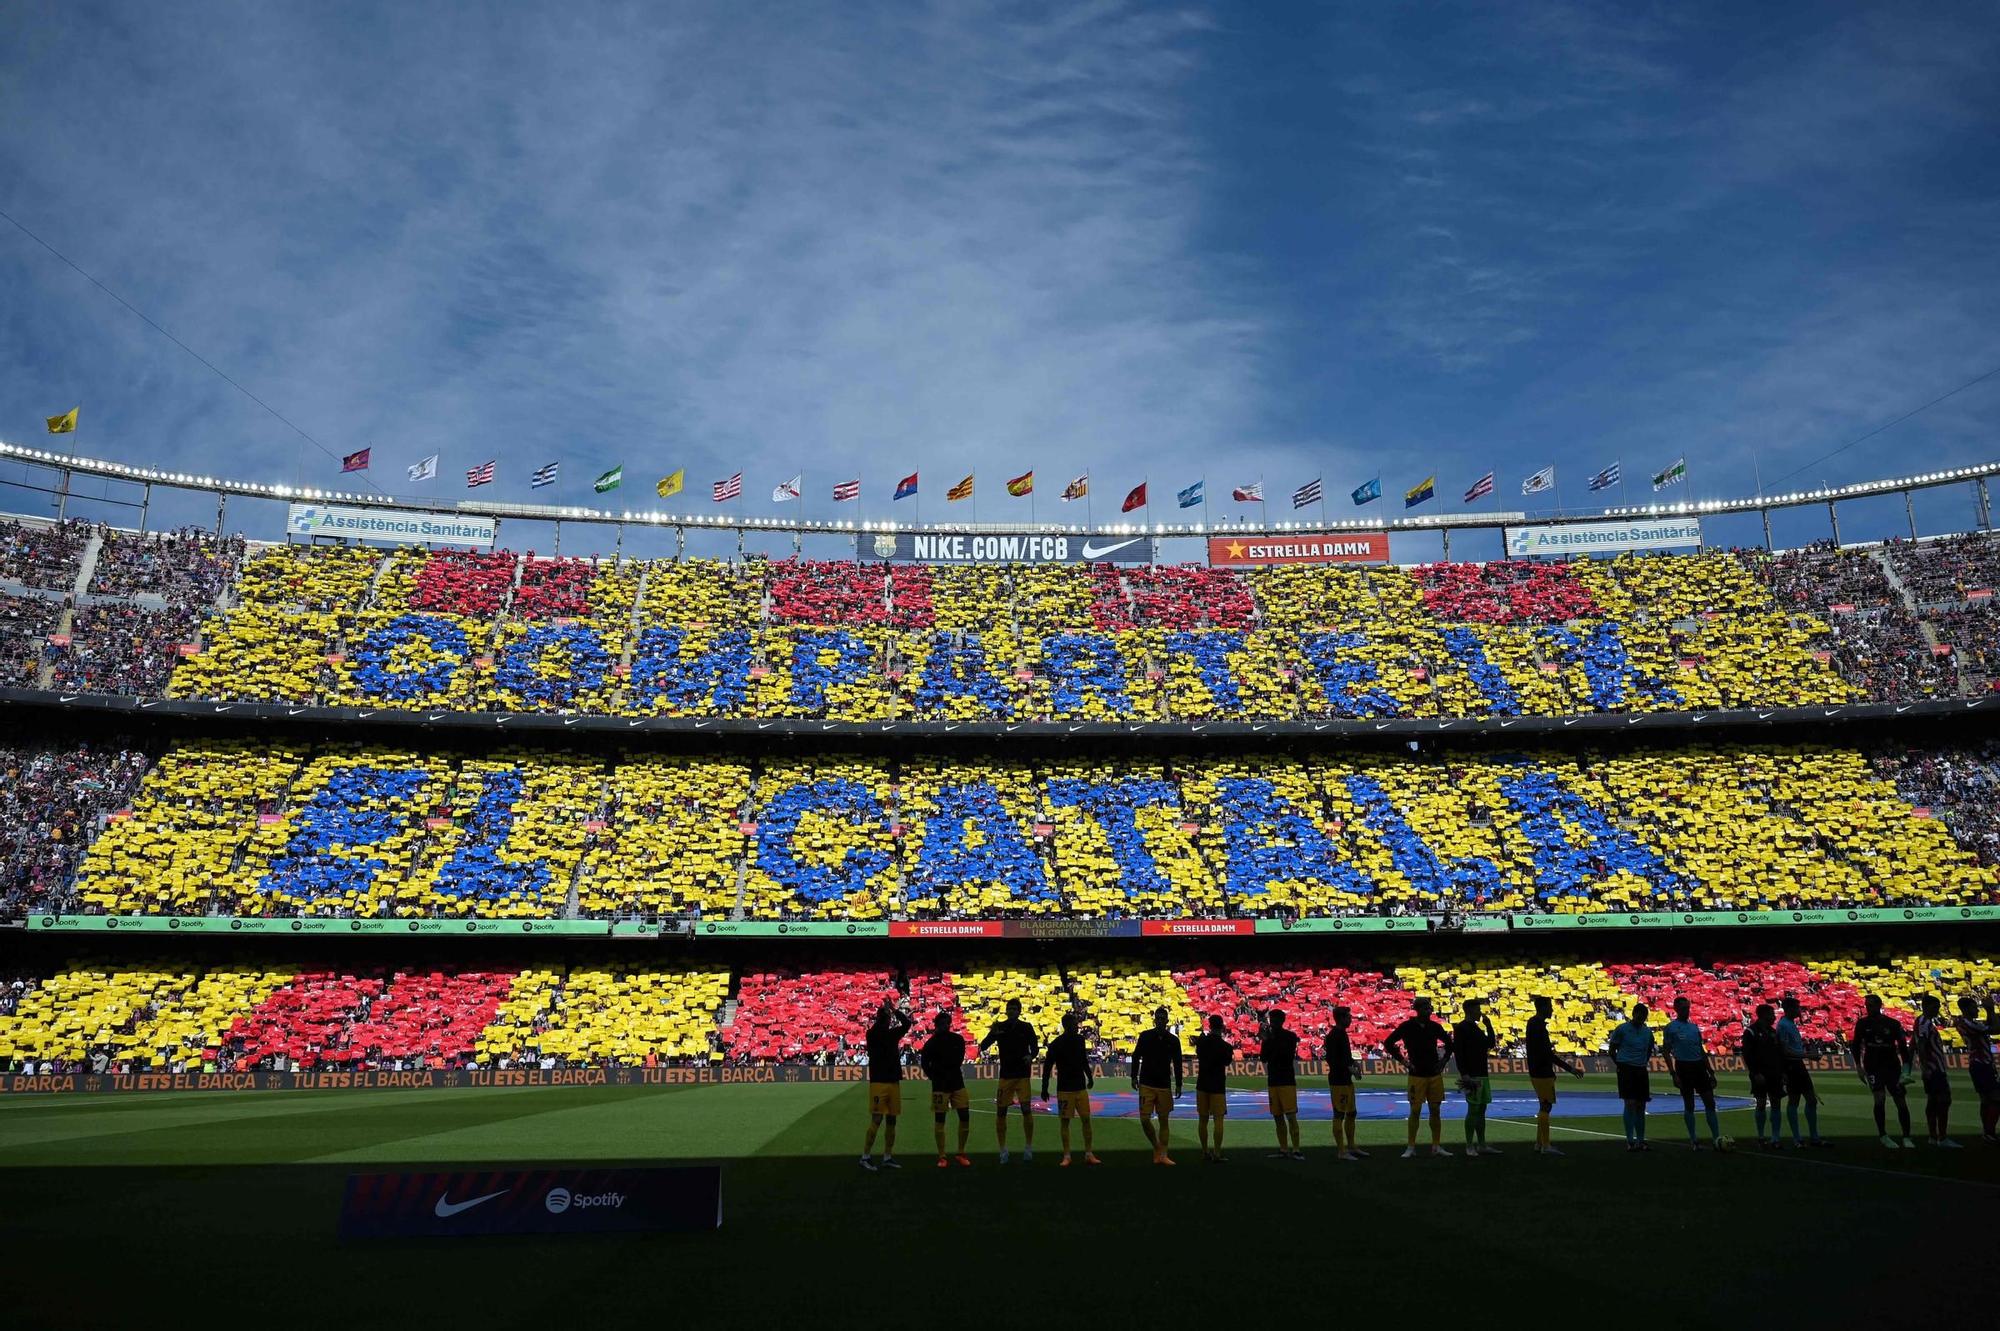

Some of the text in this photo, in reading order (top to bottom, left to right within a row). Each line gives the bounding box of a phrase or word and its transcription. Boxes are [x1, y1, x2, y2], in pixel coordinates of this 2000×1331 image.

[322, 514, 492, 539] Assistència Sanitària
[1538, 526, 1699, 546] Assistència Sanitària
[914, 536, 1068, 560] NIKE.COM/FCB
[1249, 542, 1370, 558] ESTRELLA DAMM
[256, 766, 550, 904] EL
[1803, 913, 1825, 922] Spotify
[1858, 912, 1880, 920] Spotify
[1914, 910, 1936, 919] Spotify
[1971, 909, 1995, 918] Spotify
[1534, 917, 1555, 926] Spotify
[1587, 916, 1609, 925] Spotify
[1640, 915, 1662, 924] Spotify
[1694, 915, 1716, 924] Spotify
[1748, 914, 1770, 923] Spotify
[119, 919, 143, 928] Spotify
[181, 920, 205, 929] Spotify
[242, 921, 266, 930] Spotify
[303, 922, 326, 931] Spotify
[362, 922, 384, 931] Spotify
[420, 922, 442, 931] Spotify
[477, 923, 499, 931] Spotify
[533, 923, 555, 931] Spotify
[717, 924, 738, 932] Spotify
[1081, 921, 1093, 929] AL
[1343, 920, 1364, 929] Spotify
[1395, 920, 1416, 929] Spotify
[788, 924, 809, 933] Spotify
[857, 924, 878, 933] Spotify
[920, 924, 983, 934] ESTRELLA DAMM
[1032, 928, 1046, 937] UN
[1048, 928, 1069, 937] CRIT
[1173, 924, 1235, 934] ESTRELLA DAMM
[973, 1063, 994, 1079] TU
[1225, 1061, 1264, 1077] ARÇA
[1299, 1060, 1318, 1076] TU
[470, 1069, 607, 1086] TU ETS EL BARÇA
[641, 1067, 776, 1084] TU ETS EL BARÇA
[809, 1065, 863, 1081] TU ETS
[13, 1074, 75, 1093] BARÇA
[112, 1071, 256, 1092] TU ETS EL BARÇA
[294, 1069, 434, 1091] TU ETS EL BARÇA
[573, 1192, 625, 1208] Spotify
